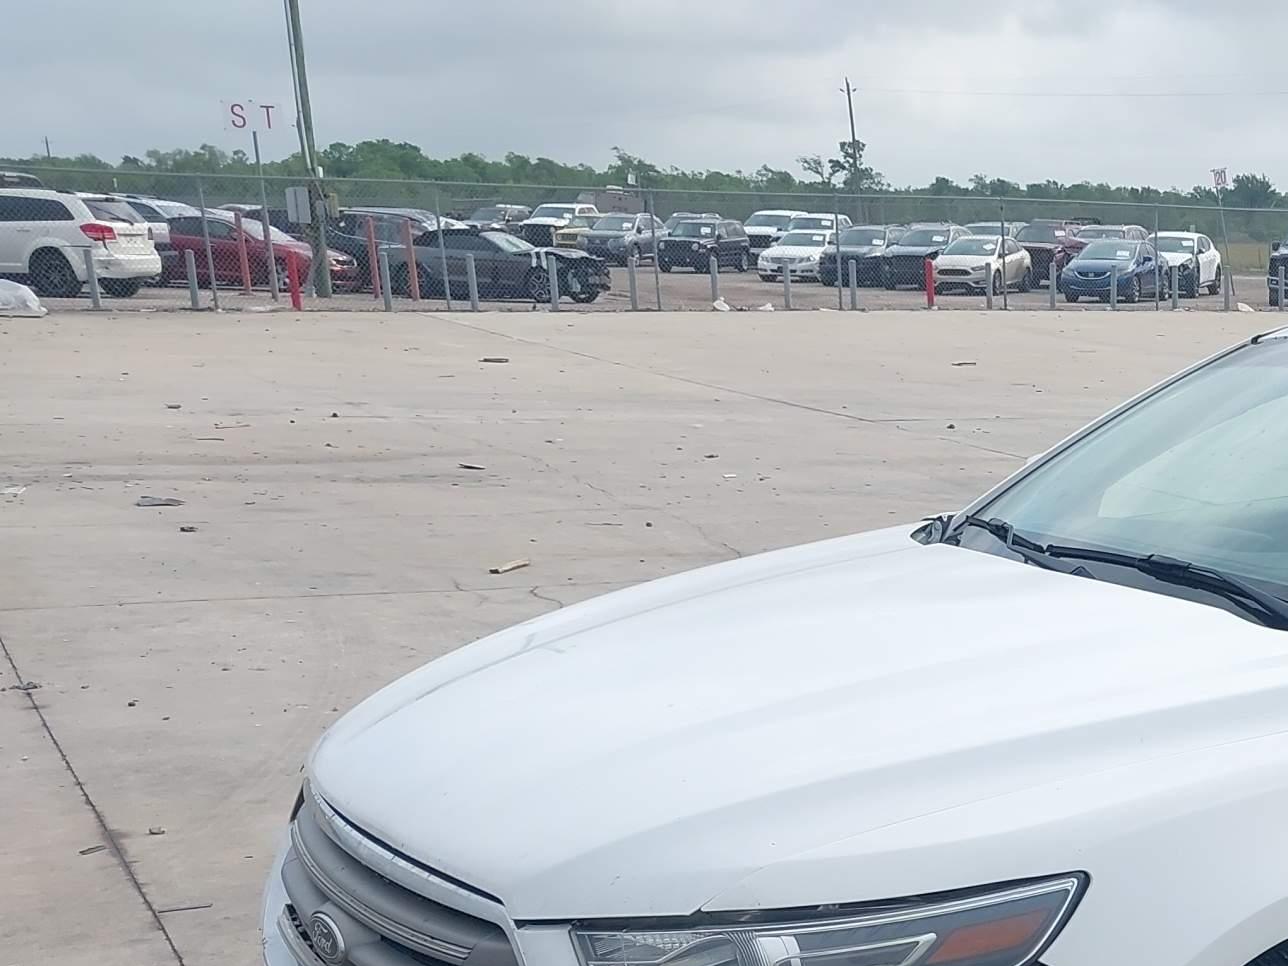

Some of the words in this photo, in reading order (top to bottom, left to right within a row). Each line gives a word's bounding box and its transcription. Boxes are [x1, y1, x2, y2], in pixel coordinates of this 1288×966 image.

[230, 103, 247, 129] S
[259, 105, 275, 129] T
[312, 922, 334, 954] Ford
